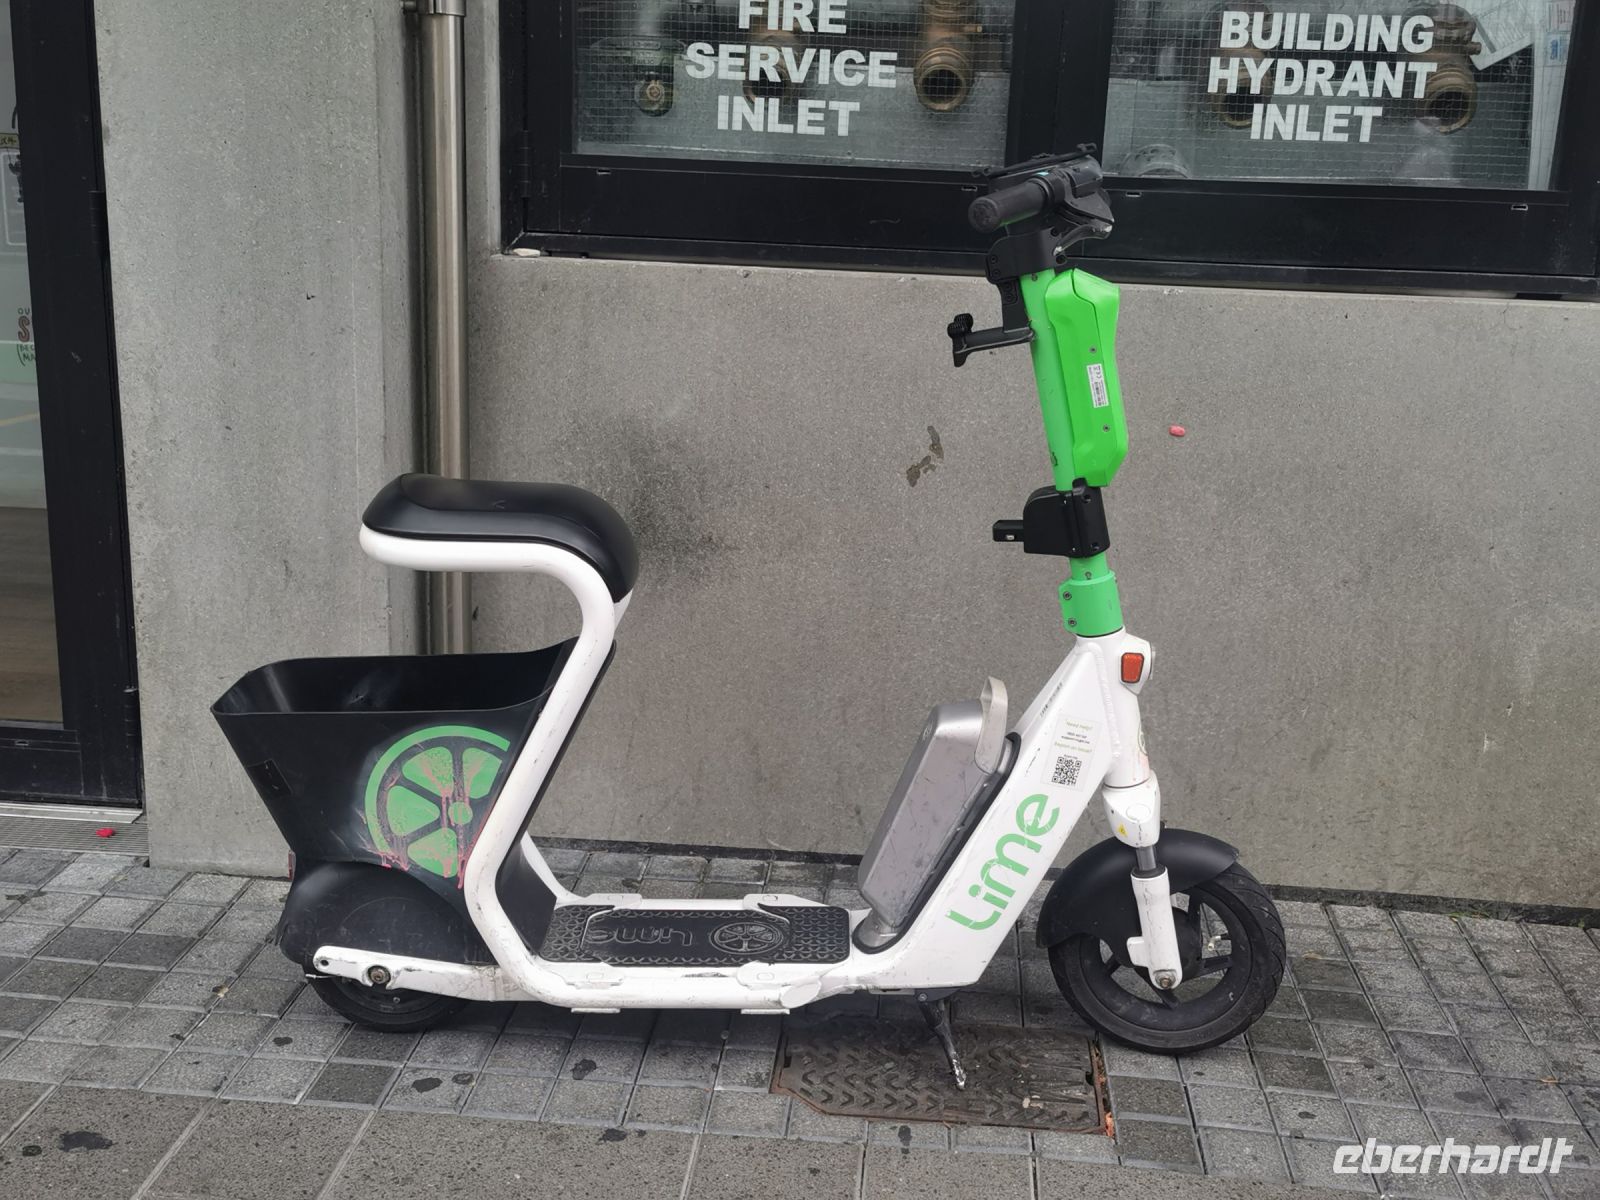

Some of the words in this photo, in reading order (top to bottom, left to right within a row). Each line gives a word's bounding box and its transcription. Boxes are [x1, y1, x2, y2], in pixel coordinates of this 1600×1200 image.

[738, 0, 848, 34] FIRE
[1219, 10, 1434, 52] BUILDING
[685, 42, 898, 88] SERVICE
[1207, 57, 1438, 99] HYDRANT
[716, 95, 860, 136] INLET
[1250, 103, 1383, 142] INLET
[945, 794, 1060, 931] Lime
